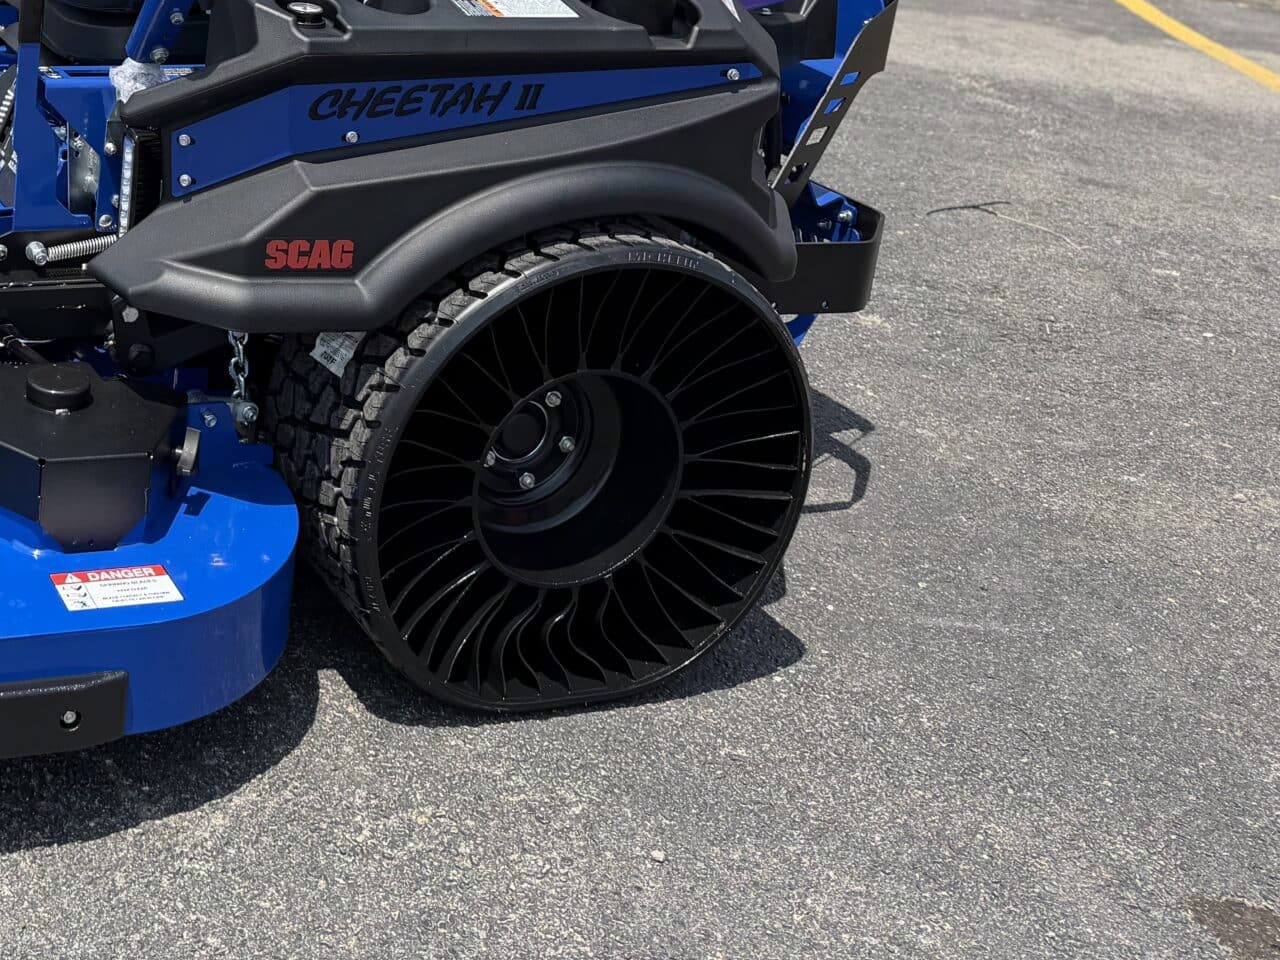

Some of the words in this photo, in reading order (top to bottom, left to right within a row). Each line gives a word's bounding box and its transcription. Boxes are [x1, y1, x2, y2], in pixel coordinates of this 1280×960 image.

[308, 80, 513, 121] CHEETAH
[265, 239, 355, 269] SCAG
[87, 566, 155, 582] DANGER
